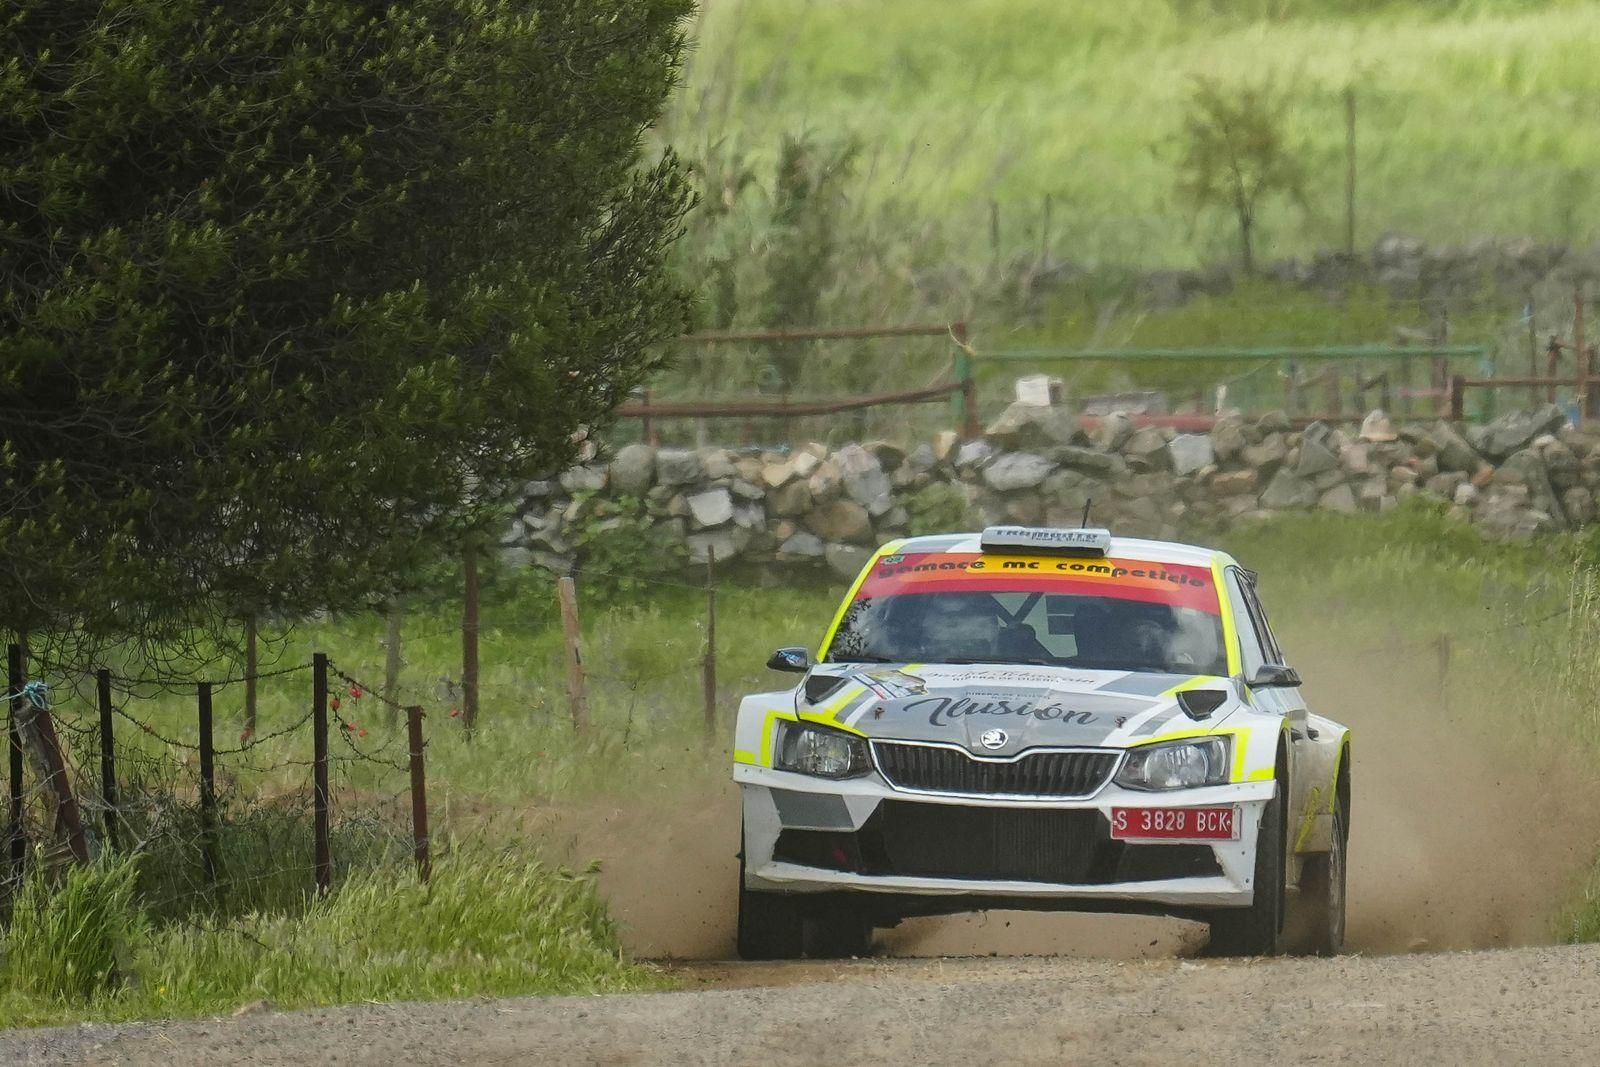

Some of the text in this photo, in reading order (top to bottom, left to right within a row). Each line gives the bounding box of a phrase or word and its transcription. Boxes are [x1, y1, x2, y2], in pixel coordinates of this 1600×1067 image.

[1003, 560, 1039, 570] mc
[902, 697, 1099, 727] Ilusión
[1116, 810, 1229, 832] S 3828 BCK
